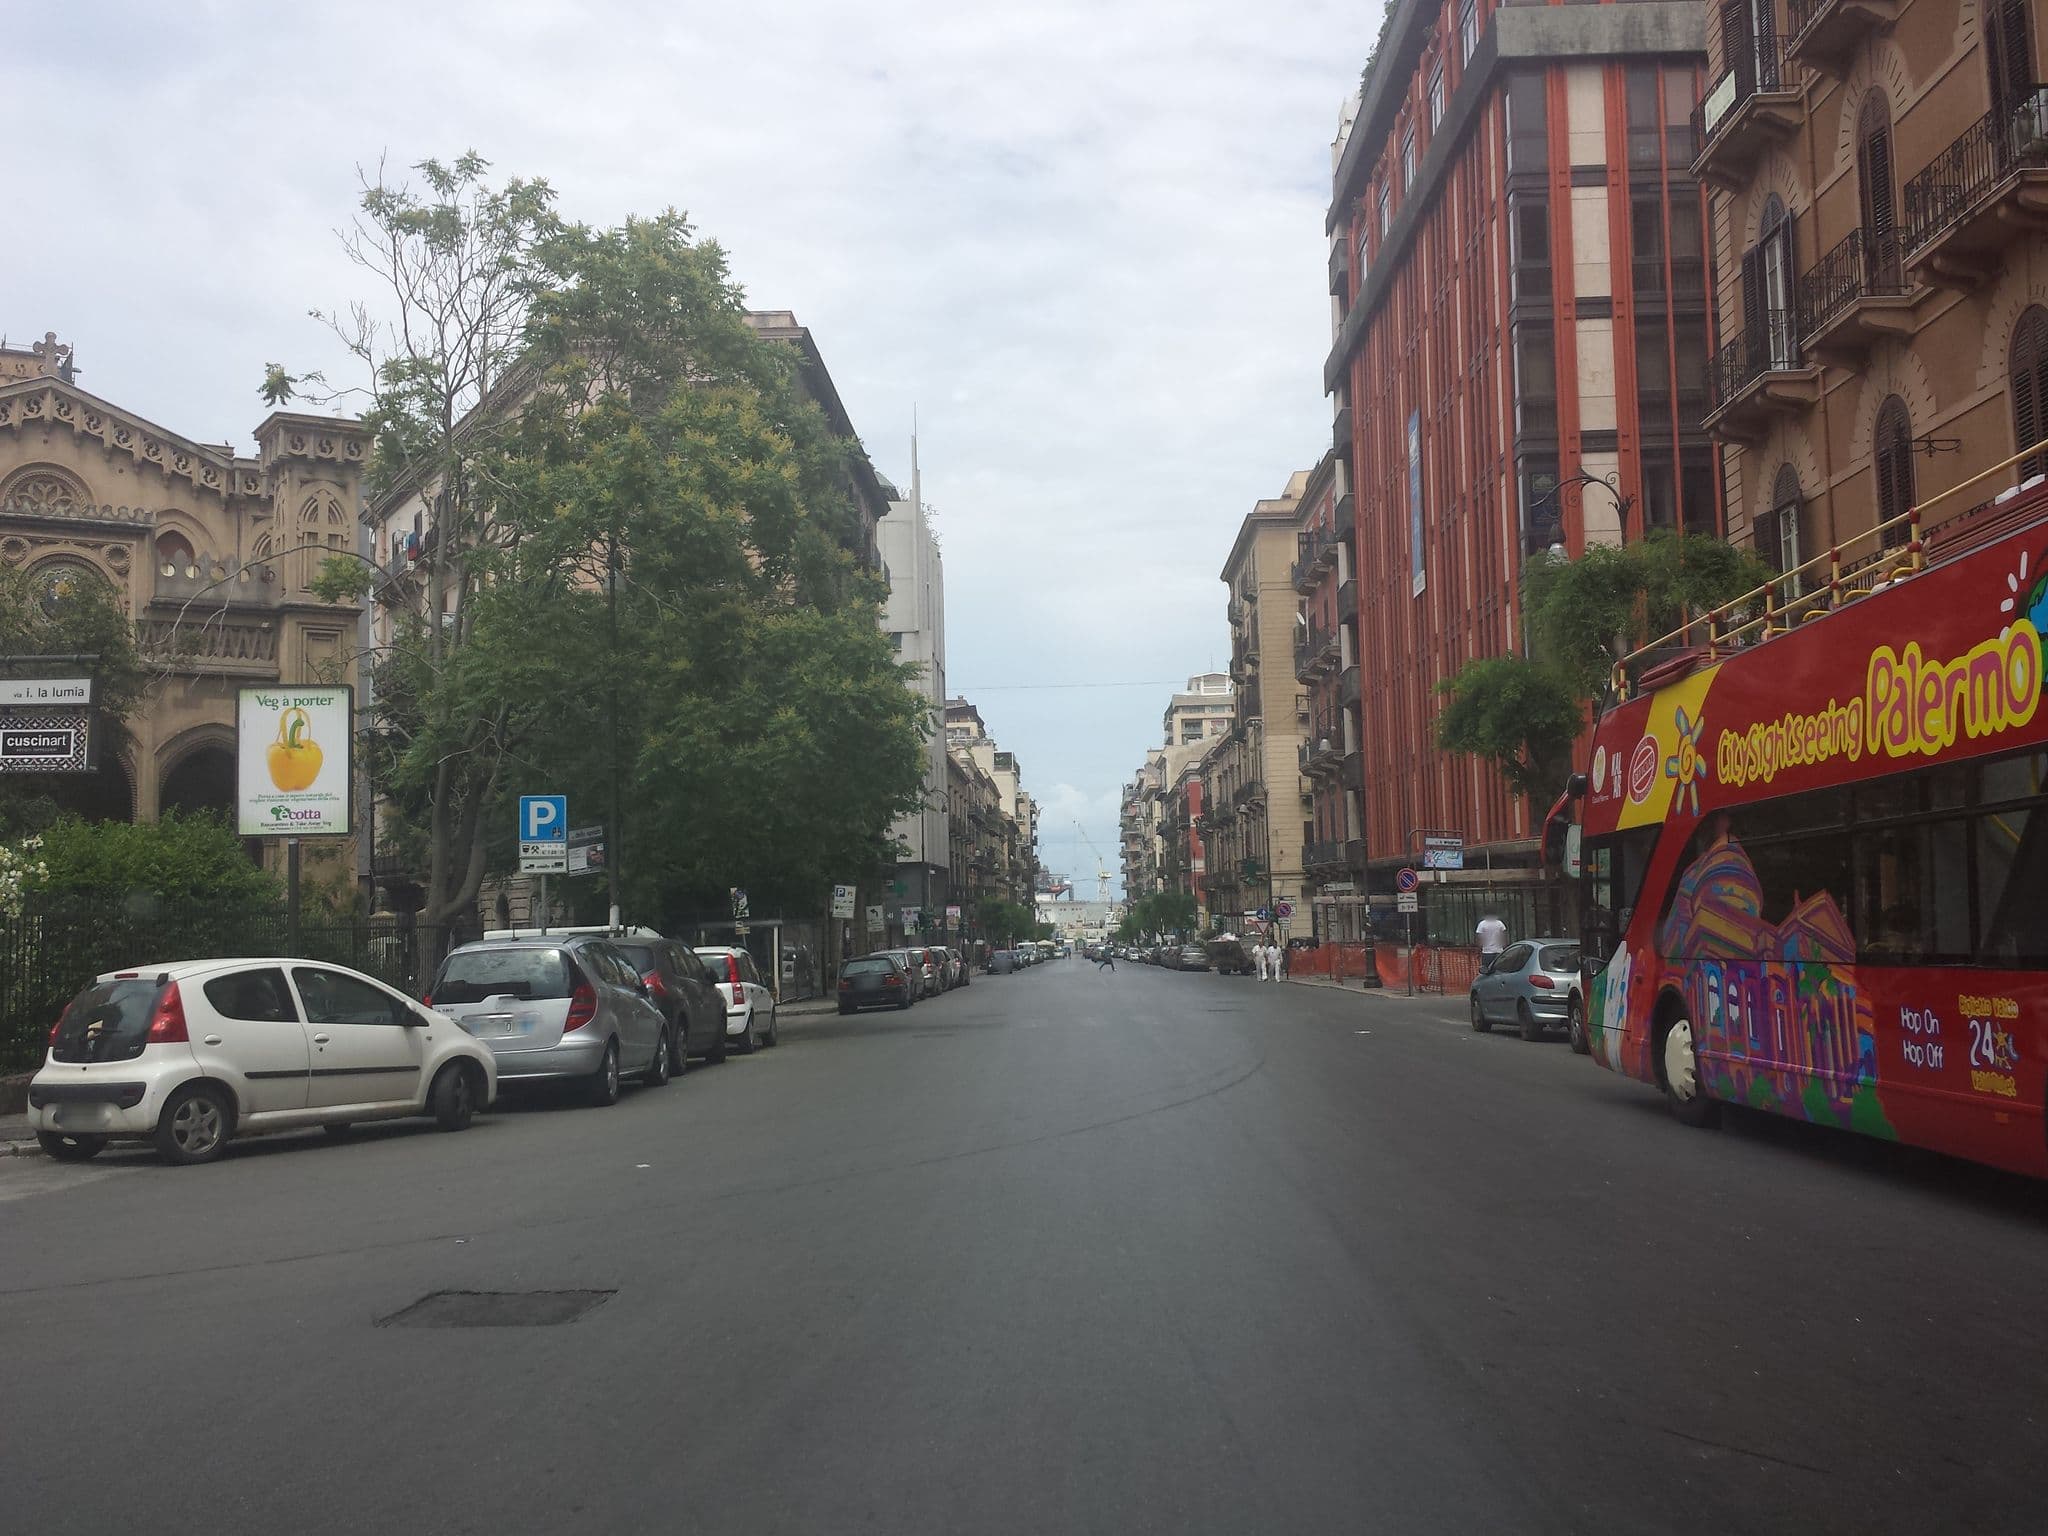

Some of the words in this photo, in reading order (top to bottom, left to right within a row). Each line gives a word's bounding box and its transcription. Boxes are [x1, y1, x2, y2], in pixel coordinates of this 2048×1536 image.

[38, 687, 48, 698] la
[52, 686, 85, 697] lumia
[256, 695, 279, 711] Veg
[293, 696, 334, 710] porter
[7, 734, 66, 747] cuscinart
[529, 800, 557, 837] P
[1901, 1007, 1921, 1034] Hop
[1924, 1008, 1940, 1034] On
[1903, 1039, 1924, 1068] Hop
[1926, 1042, 1943, 1068] Off
[1969, 1019, 1994, 1066] 24
